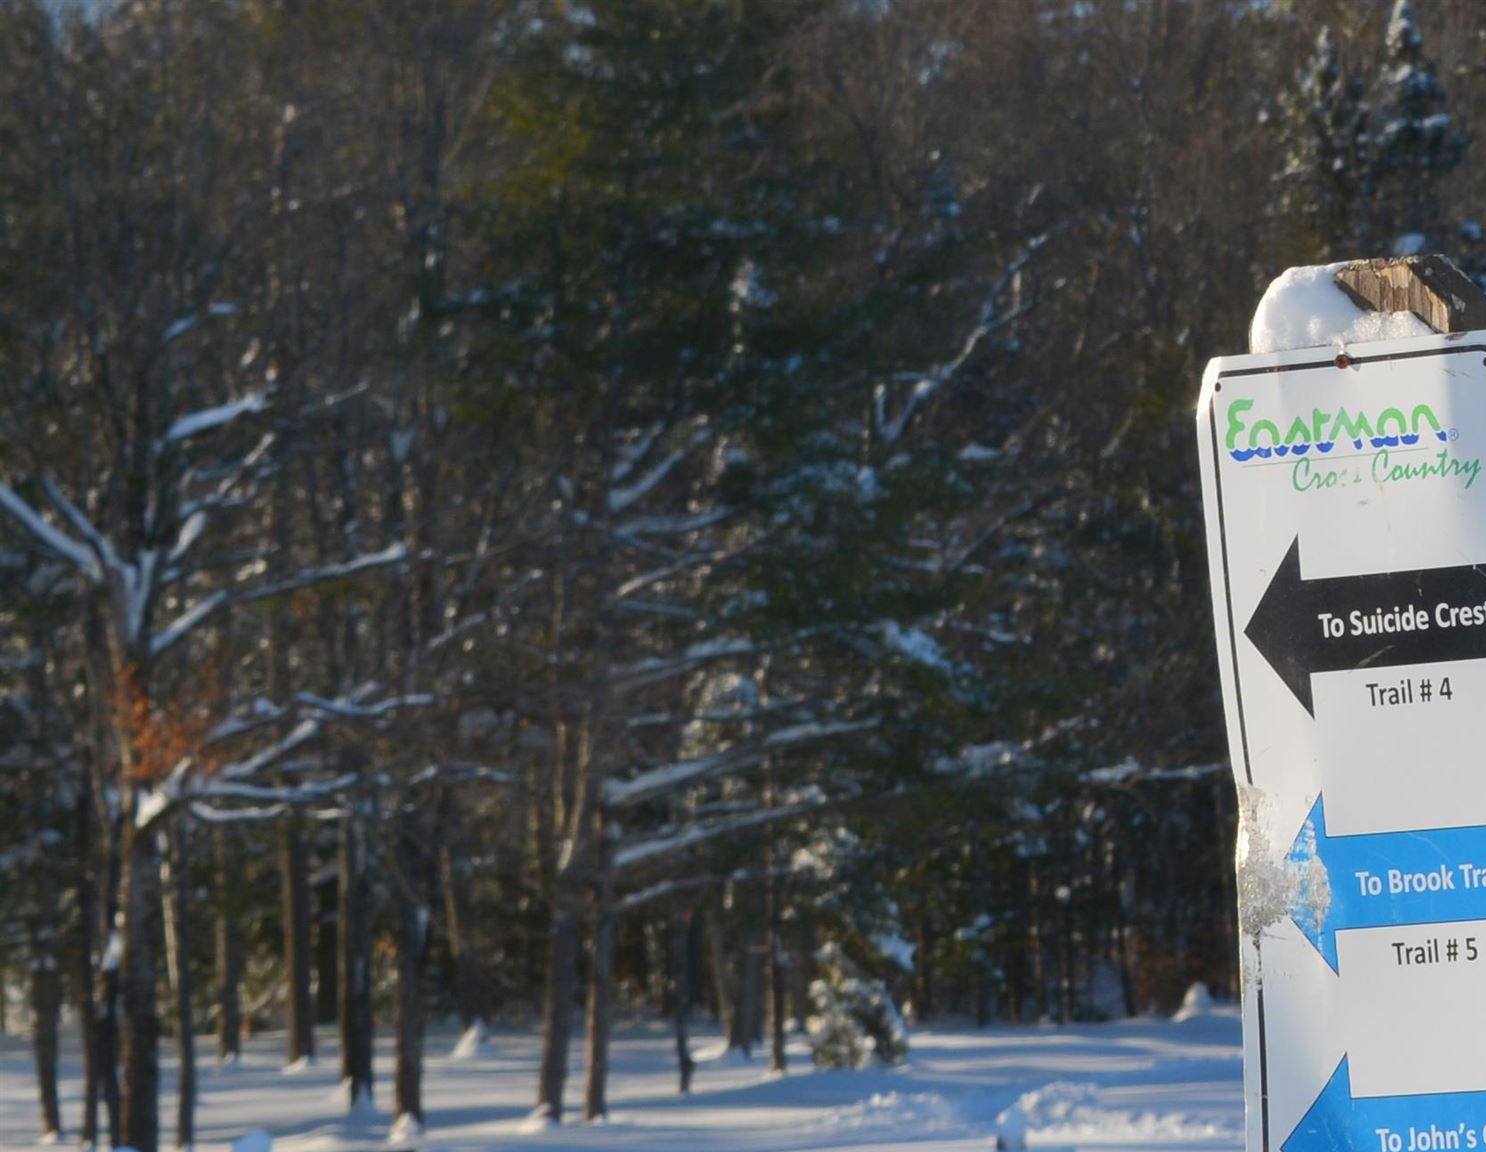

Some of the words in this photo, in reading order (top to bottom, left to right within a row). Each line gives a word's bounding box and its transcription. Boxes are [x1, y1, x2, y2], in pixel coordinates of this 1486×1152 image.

[1292, 457, 1363, 492] Cro
[1371, 449, 1482, 489] Country
[1318, 613, 1345, 639] To
[1350, 604, 1430, 636] Suicide
[1366, 681, 1413, 707] Trail
[1419, 681, 1433, 702] #
[1439, 677, 1453, 701] 4
[1355, 871, 1382, 897] To
[1388, 865, 1455, 893] Brook
[1392, 939, 1440, 966] Trail
[1445, 939, 1459, 962] #
[1465, 937, 1479, 961] 5
[1376, 1128, 1402, 1152] To
